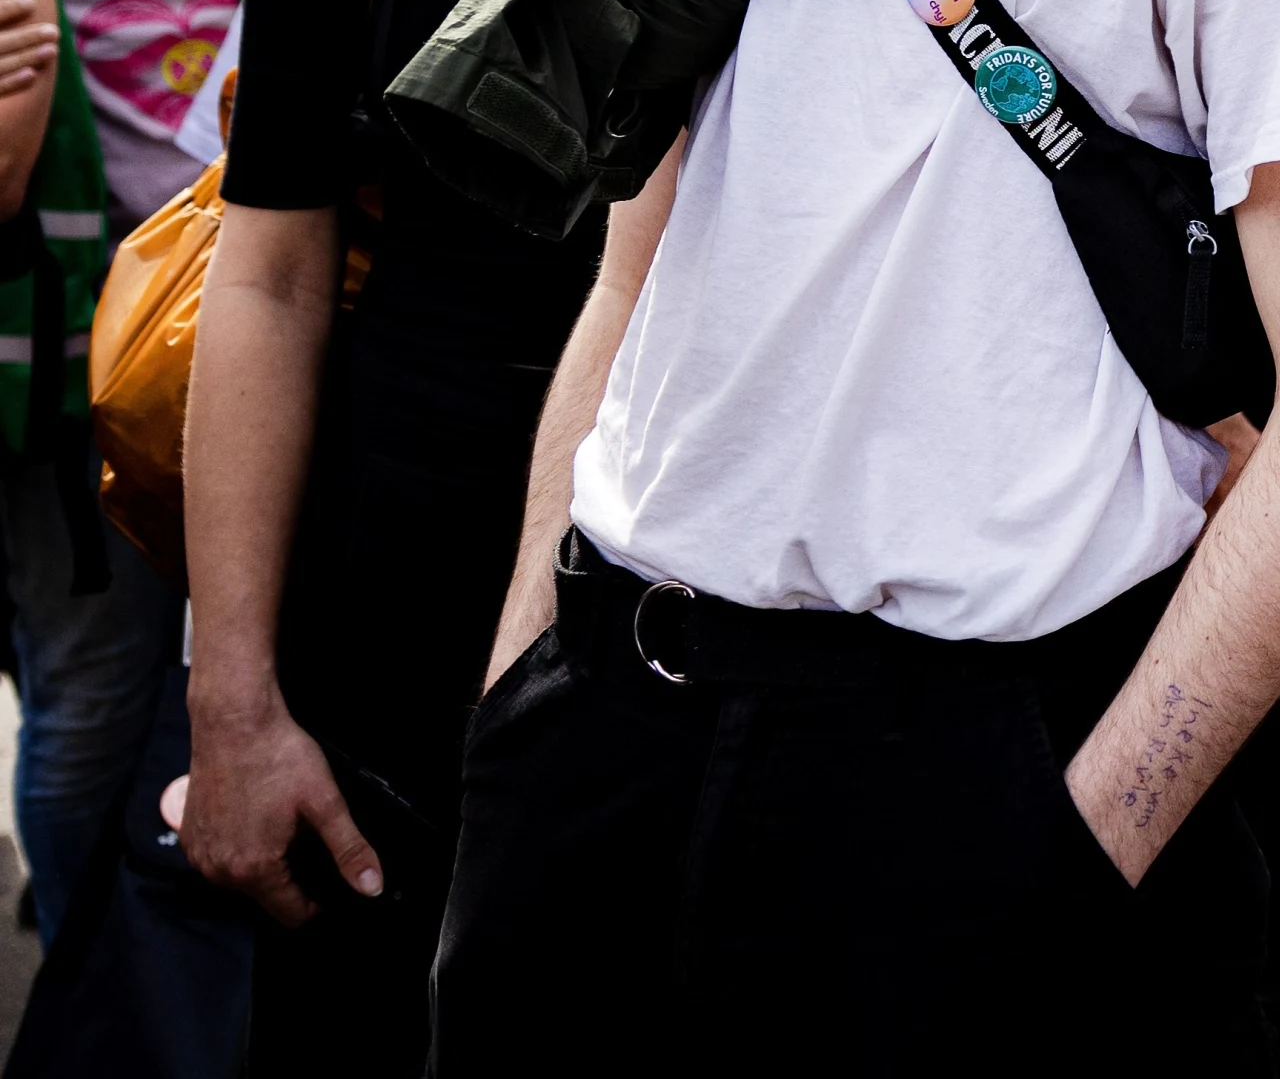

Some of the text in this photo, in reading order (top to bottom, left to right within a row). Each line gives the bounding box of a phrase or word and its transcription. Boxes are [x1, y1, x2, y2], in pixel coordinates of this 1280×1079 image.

[978, 86, 999, 117] Sweden
[986, 52, 1053, 124] FRIDAYS FOR FUTURE
